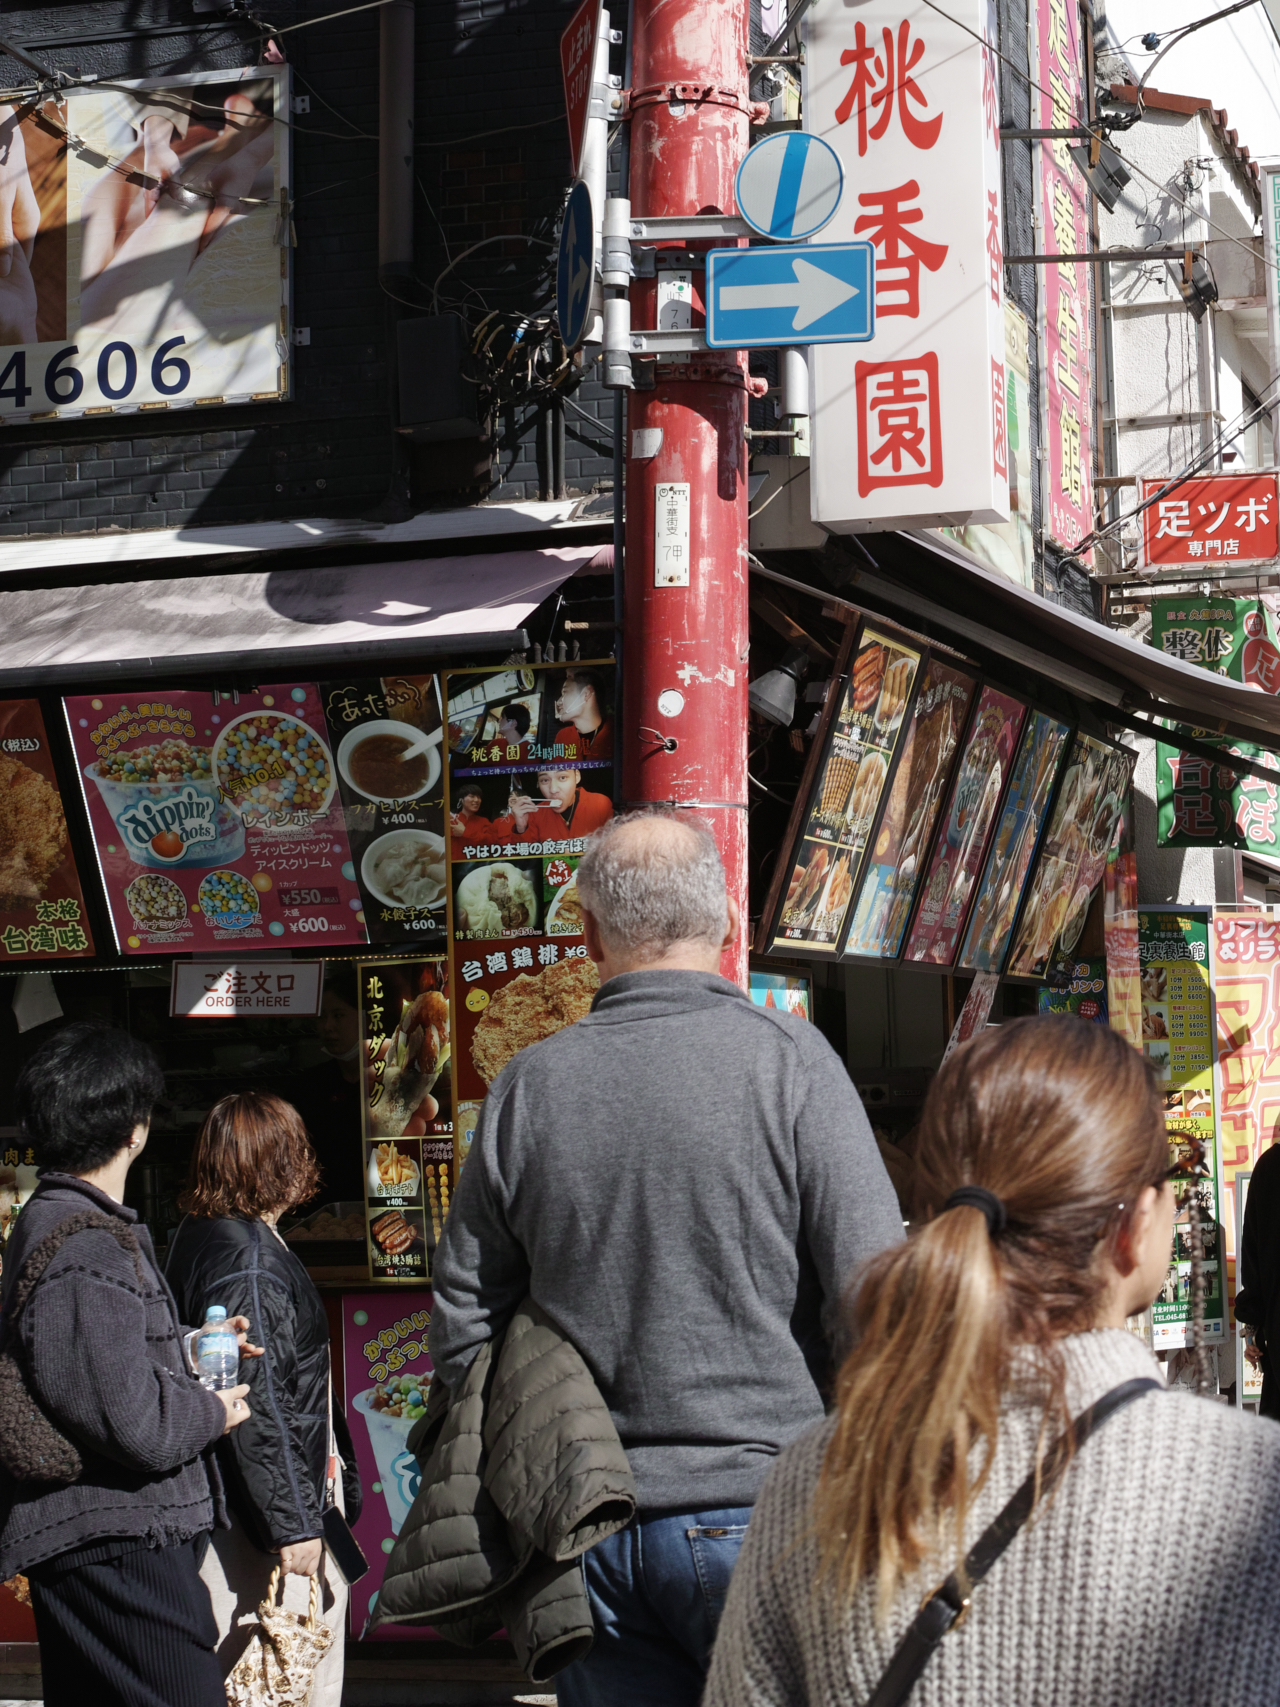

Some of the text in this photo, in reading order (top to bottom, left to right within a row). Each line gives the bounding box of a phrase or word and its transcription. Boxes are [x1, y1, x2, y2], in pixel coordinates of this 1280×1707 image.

[567, 15, 592, 77] 止まれ
[570, 63, 588, 110] STOP
[835, 19, 949, 499] 桃香園
[981, 25, 1008, 484] 桃香園
[0, 335, 191, 408] 4606
[666, 498, 679, 536] 中華街支
[1154, 493, 1273, 540] 足ツボ
[1187, 539, 1240, 557] 専門店
[1162, 628, 1232, 661] 整体
[1247, 646, 1280, 689] 足
[338, 689, 411, 722] あったかい
[90, 703, 192, 744] かわいい、美味しい
[471, 744, 521, 763] 桃香園
[216, 760, 286, 804] 人気NO.1
[124, 789, 212, 844] dippin'
[242, 809, 328, 829] レインボー
[382, 813, 415, 825] ¥400
[255, 857, 332, 871] アイスクリーム
[546, 859, 567, 875] 人気
[279, 880, 297, 888] 1カップ
[281, 889, 322, 905] ¥550
[36, 897, 82, 921] 本格
[283, 908, 301, 917] 大盛
[289, 917, 329, 933] ¥600
[403, 919, 436, 931] ¥600
[455, 929, 499, 940] 特製肉まん
[1, 923, 88, 953] 台湾味
[1138, 941, 1206, 961] 足裏養生館
[461, 943, 559, 983] 台湾鶏排
[203, 971, 296, 994] ご注文口
[205, 996, 291, 1007] ORDER HERE
[366, 975, 386, 1108] 北京ダック
[377, 1183, 414, 1196] 台湾ポテト
[386, 1198, 403, 1206] ¥400
[377, 1254, 422, 1266] 台湾焼き腸詰
[1154, 1313, 1194, 1321] TEL:045-681-
[363, 1309, 431, 1361] かわいい
